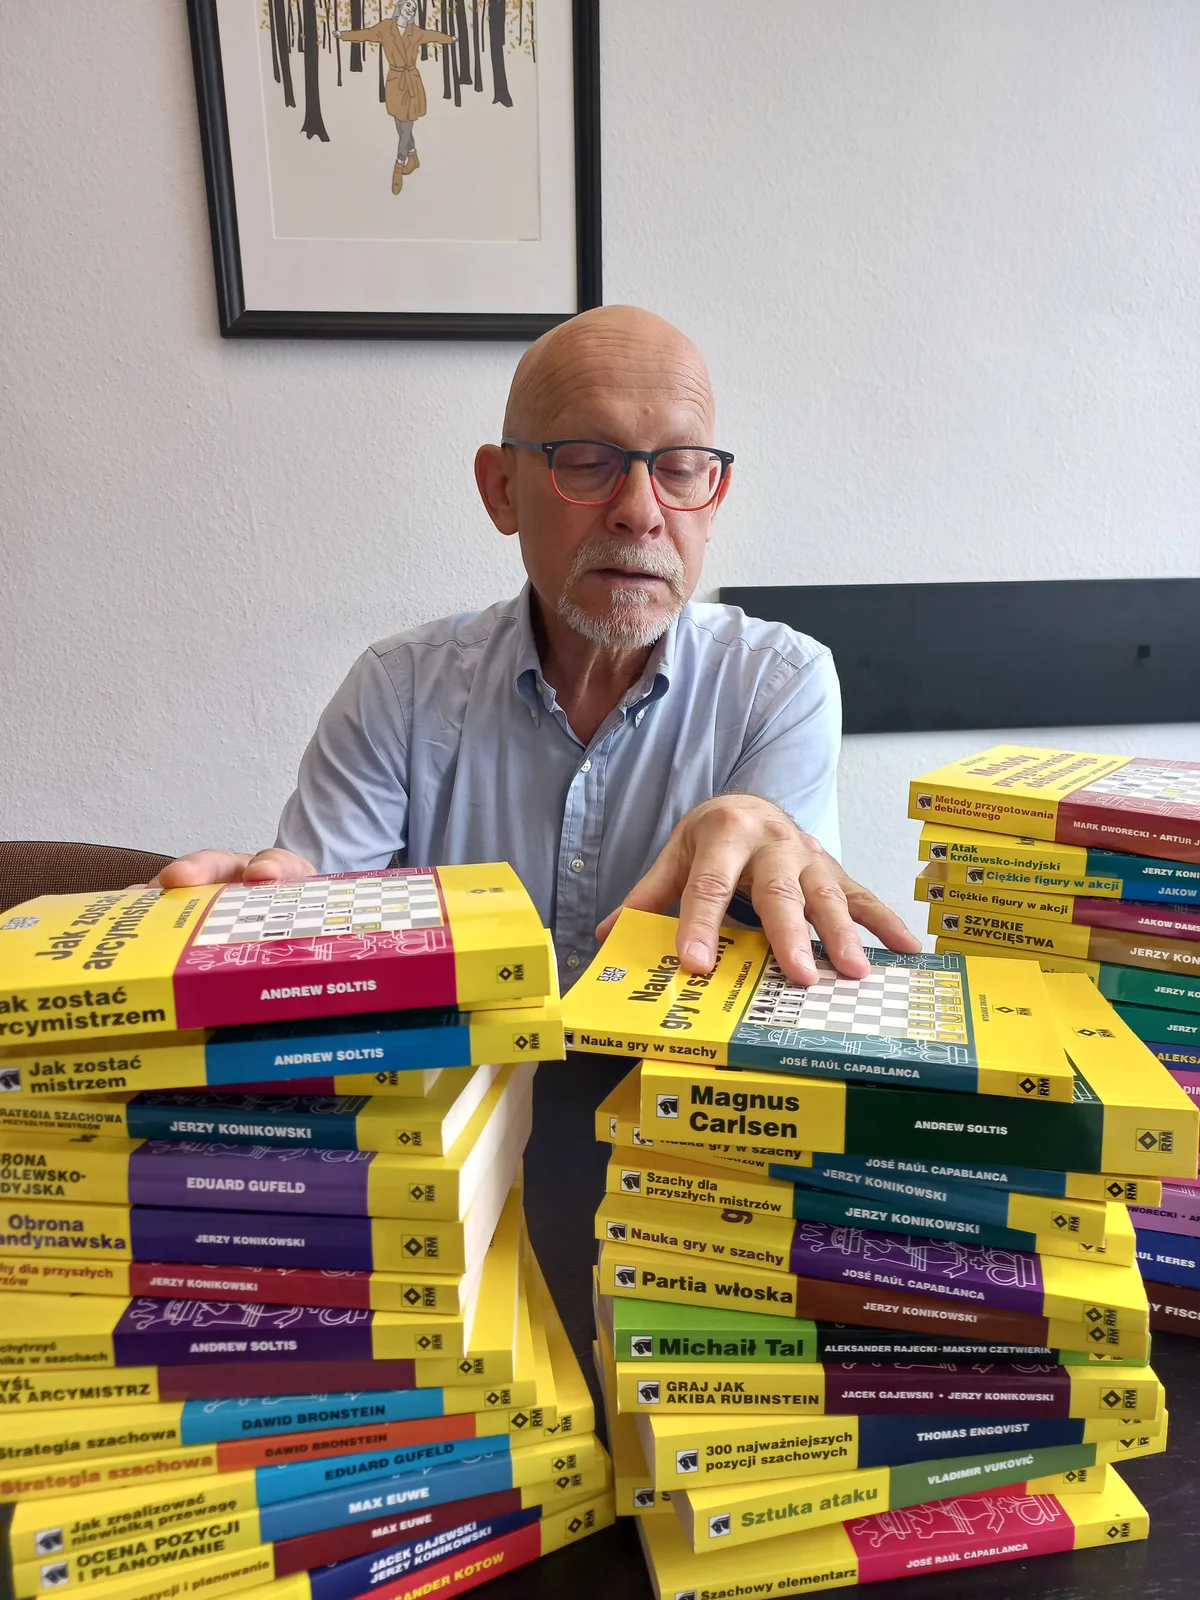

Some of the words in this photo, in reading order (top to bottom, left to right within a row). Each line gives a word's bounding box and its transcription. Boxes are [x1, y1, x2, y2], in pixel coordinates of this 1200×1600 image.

[934, 804, 1001, 821] debiutowego
[935, 795, 973, 809] Metody
[975, 800, 1054, 820] przygotowania
[1073, 821, 1099, 831] MARK
[1101, 824, 1150, 838] DWORECKI
[1159, 833, 1192, 845] ARTUR
[950, 844, 978, 854] Atak
[950, 852, 1061, 872] królewsko-indyjski
[1142, 867, 1174, 876] JERZY
[986, 871, 1031, 884] Ciężkie
[1034, 876, 1070, 889] figury
[1075, 880, 1085, 888] w
[1088, 881, 1119, 891] akcji
[948, 889, 989, 903] Ciężkie
[991, 895, 1023, 909] figury
[1027, 900, 1037, 909] w
[1040, 902, 1068, 914] akcji
[1158, 887, 1198, 897] JAKOW
[964, 914, 1024, 932] SZYBKIE
[1138, 918, 1173, 928] JAKOW
[35, 929, 91, 961] Jak
[964, 926, 1054, 949] ZWYCIĘSTWA
[1130, 947, 1170, 960] JERZY
[627, 955, 682, 1002] Nauka
[37, 986, 128, 1010] zostać
[260, 984, 323, 1001] ANDREW
[327, 980, 378, 995] SOLTIS
[676, 989, 703, 1002] w
[1154, 986, 1185, 996] JERZY
[659, 1004, 700, 1030] gry
[1167, 1024, 1198, 1034] JERZY
[274, 1051, 333, 1066] ANDREW
[336, 1048, 384, 1062] SOLTIS
[580, 1034, 623, 1049] Nauka
[627, 1041, 649, 1053] gry
[653, 1044, 665, 1052] w
[669, 1045, 717, 1059] szachy
[29, 1060, 65, 1077] Jak
[74, 1055, 142, 1073] zostać
[779, 1056, 808, 1068] JOSÉ
[811, 1058, 841, 1071] RAÚL
[844, 1062, 920, 1079] CAPABLANCA
[31, 1075, 127, 1094] mistrzem
[1039, 1078, 1050, 1096] RM
[690, 1084, 800, 1112] Magnus
[54, 1111, 123, 1124] SZACHOWA
[689, 1111, 797, 1139] Carlsen
[914, 1120, 965, 1133] ANDREW
[967, 1123, 1008, 1135] SOLTIS
[169, 1120, 214, 1134] JERZY
[218, 1123, 313, 1139] KONIKOWSKI
[1161, 1131, 1172, 1152] RM
[865, 1157, 895, 1169] JOSÉ
[898, 1159, 929, 1174] RAÚL
[931, 1166, 1008, 1182] CAPABLANCA
[186, 1177, 245, 1192] EDUARD
[248, 1179, 306, 1194] GUFELD
[646, 1172, 694, 1190] Szachy
[697, 1179, 718, 1191] dla
[823, 1169, 861, 1184] JERZY
[864, 1176, 947, 1202] KONIKOWSKI
[646, 1185, 715, 1203] przyszłych
[719, 1196, 782, 1213] mistrzów
[8, 1214, 84, 1232] Obrona
[845, 1207, 888, 1222] JERZY
[891, 1212, 980, 1234] KONIKOWSKI
[195, 1234, 230, 1245] JERZY
[233, 1236, 306, 1248] KONIKOWSKI
[426, 1236, 439, 1257] RM
[631, 1228, 678, 1246] Nauka
[683, 1239, 707, 1253] gry
[712, 1244, 725, 1254] w
[730, 1245, 784, 1267] szachy
[1157, 1254, 1196, 1268] KERES
[19, 1264, 39, 1275] dla
[43, 1266, 114, 1280] przyszłych
[150, 1277, 184, 1288] JERZY
[187, 1279, 259, 1293] KONIKOWSKI
[642, 1272, 707, 1293] Partia
[715, 1282, 794, 1304] włoska
[842, 1267, 872, 1282] JOSÉ
[874, 1272, 905, 1288] RAÚL
[907, 1280, 985, 1301] CAPABLANCA
[863, 1301, 899, 1314] JERZY
[902, 1306, 978, 1323] KONIKOWSKI
[45, 1351, 108, 1363] szachach
[190, 1342, 247, 1354] ANDREW
[250, 1340, 298, 1352] SOLTIS
[659, 1338, 756, 1357] Michaił
[765, 1338, 804, 1357] Tal
[825, 1344, 891, 1354] ALEKSANDER
[989, 1345, 1052, 1355] CZETWIERIK
[27, 1384, 151, 1404] ARCYMISTRZ
[666, 1381, 709, 1393] GRAJ
[713, 1382, 745, 1393] JAK
[841, 1390, 876, 1400] JACEK
[878, 1390, 934, 1400] GAJEWSKI
[948, 1391, 982, 1401] JERZY
[985, 1391, 1055, 1402] KONIKOWSKI
[666, 1394, 716, 1405] AKIBA
[720, 1394, 819, 1405] RUBINSTEIN
[1126, 1389, 1137, 1409] RM
[242, 1415, 293, 1431] DAWID
[296, 1404, 386, 1425] BRONSTEIN
[86, 1428, 177, 1449] szachowa
[917, 1428, 967, 1442] THOMAS
[969, 1423, 1030, 1438] ENGQVIST
[264, 1444, 308, 1457] DAWID
[312, 1433, 388, 1451] BRONSTEIN
[706, 1444, 732, 1457] 300
[736, 1432, 853, 1456] najważniejszych
[324, 1458, 390, 1481] EDUARD
[394, 1443, 454, 1465] GUFELD
[706, 1455, 756, 1473] pozycji
[760, 1446, 848, 1465] szachowych
[928, 1466, 981, 1485] VLADIMIR
[984, 1454, 1034, 1473] VUKOVIĆ
[0, 1469, 102, 1495] Strategia
[108, 1454, 213, 1480] szachowa
[348, 1497, 383, 1514] MAX
[386, 1487, 430, 1507] EUWE
[740, 1500, 813, 1527] Sztuka
[819, 1488, 879, 1511] ataku
[70, 1515, 102, 1534] Jak
[106, 1493, 206, 1526] zrealizować
[71, 1520, 154, 1547] niewielką
[158, 1499, 238, 1529] przewagę
[371, 1523, 397, 1539] MAX
[399, 1513, 432, 1530] EUWE
[76, 1541, 149, 1568] OCENA
[155, 1520, 241, 1550] POZYCJI
[369, 1547, 412, 1573] JACEK
[414, 1521, 477, 1555] GAJEWSKI
[370, 1561, 412, 1584] JERZY
[414, 1525, 492, 1566] KONIKOWSKI
[78, 1571, 85, 1582] I
[91, 1540, 226, 1580] PLANOWANIE
[906, 1556, 933, 1569] JOSÉ
[935, 1551, 961, 1564] RAÚL
[963, 1543, 1028, 1560] CAPABLANCA
[192, 1561, 270, 1592] planowanie
[454, 1552, 505, 1582] KOTOW
[777, 1568, 857, 1589] elementarz
